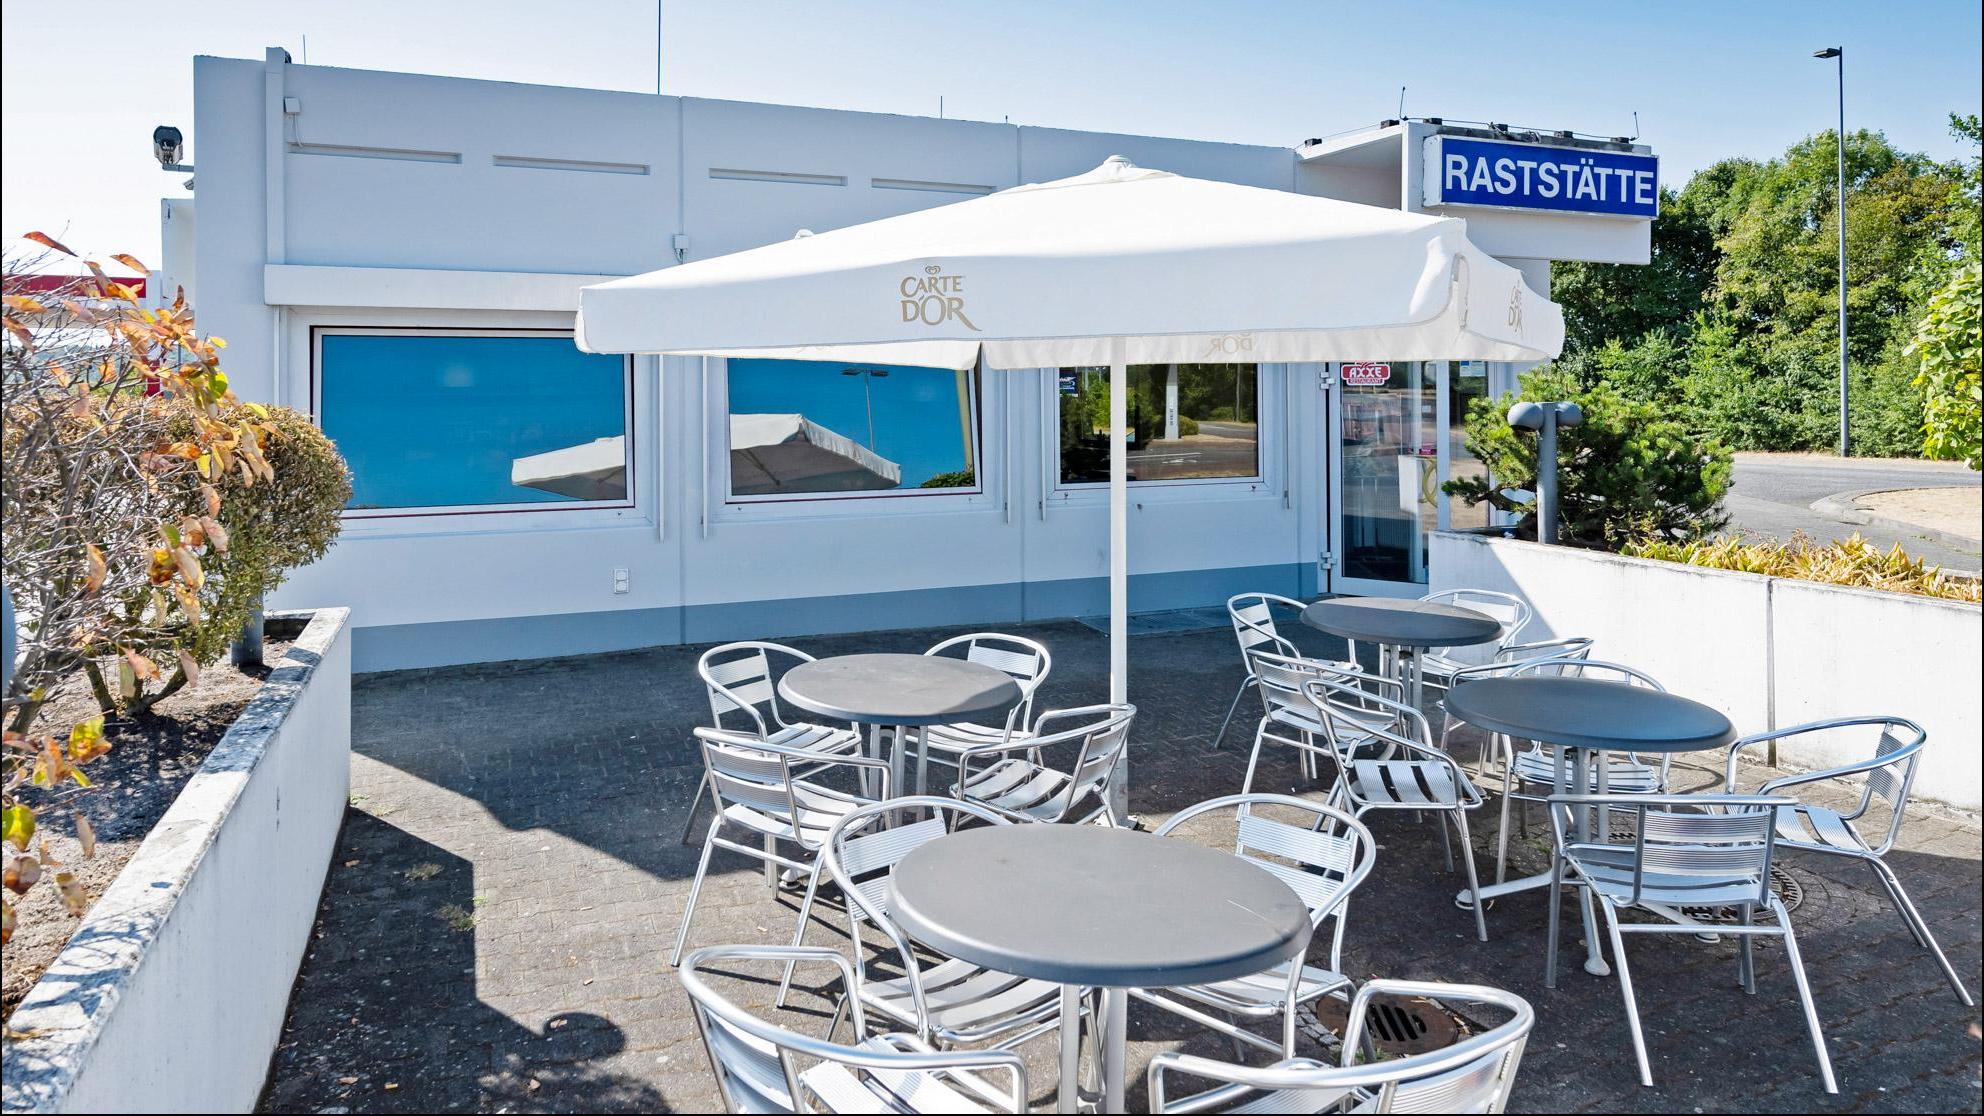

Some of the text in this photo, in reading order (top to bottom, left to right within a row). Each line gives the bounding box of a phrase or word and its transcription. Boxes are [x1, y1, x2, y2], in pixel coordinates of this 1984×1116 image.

[1445, 153, 1654, 204] RASTSTÄTTE
[900, 275, 966, 298] CARTE
[900, 294, 983, 332] D'OR
[1349, 367, 1383, 378] AXXE
